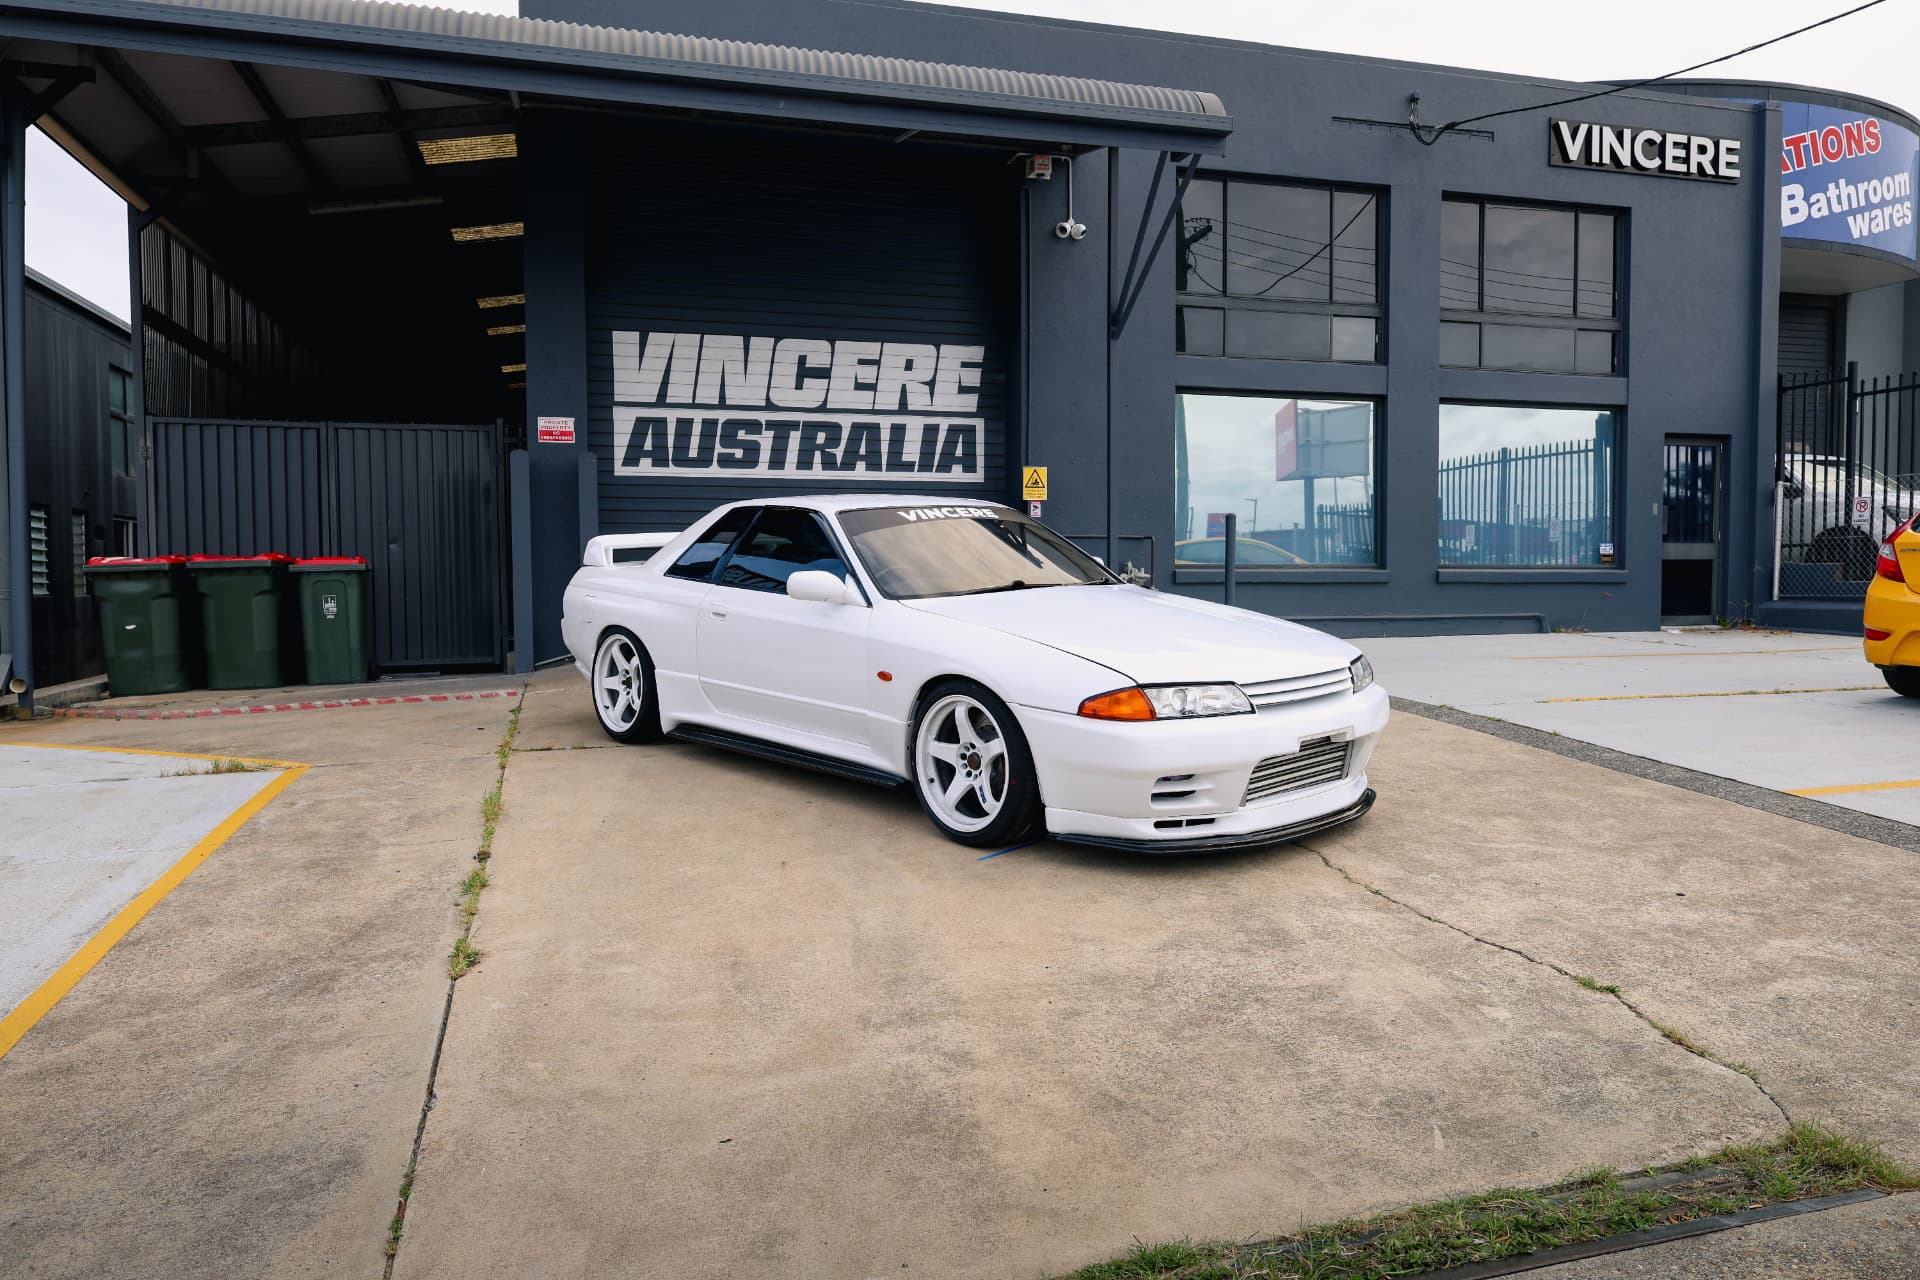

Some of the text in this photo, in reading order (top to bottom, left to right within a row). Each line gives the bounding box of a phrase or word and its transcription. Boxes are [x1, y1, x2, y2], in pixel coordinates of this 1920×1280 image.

[1558, 120, 1741, 178] VINCERE
[1781, 171, 1910, 227] Bathroom
[1847, 201, 1912, 239] wares
[612, 331, 985, 412] VINCERE
[621, 416, 977, 474] AUSTRALIA
[897, 507, 1000, 522] VINCERE
